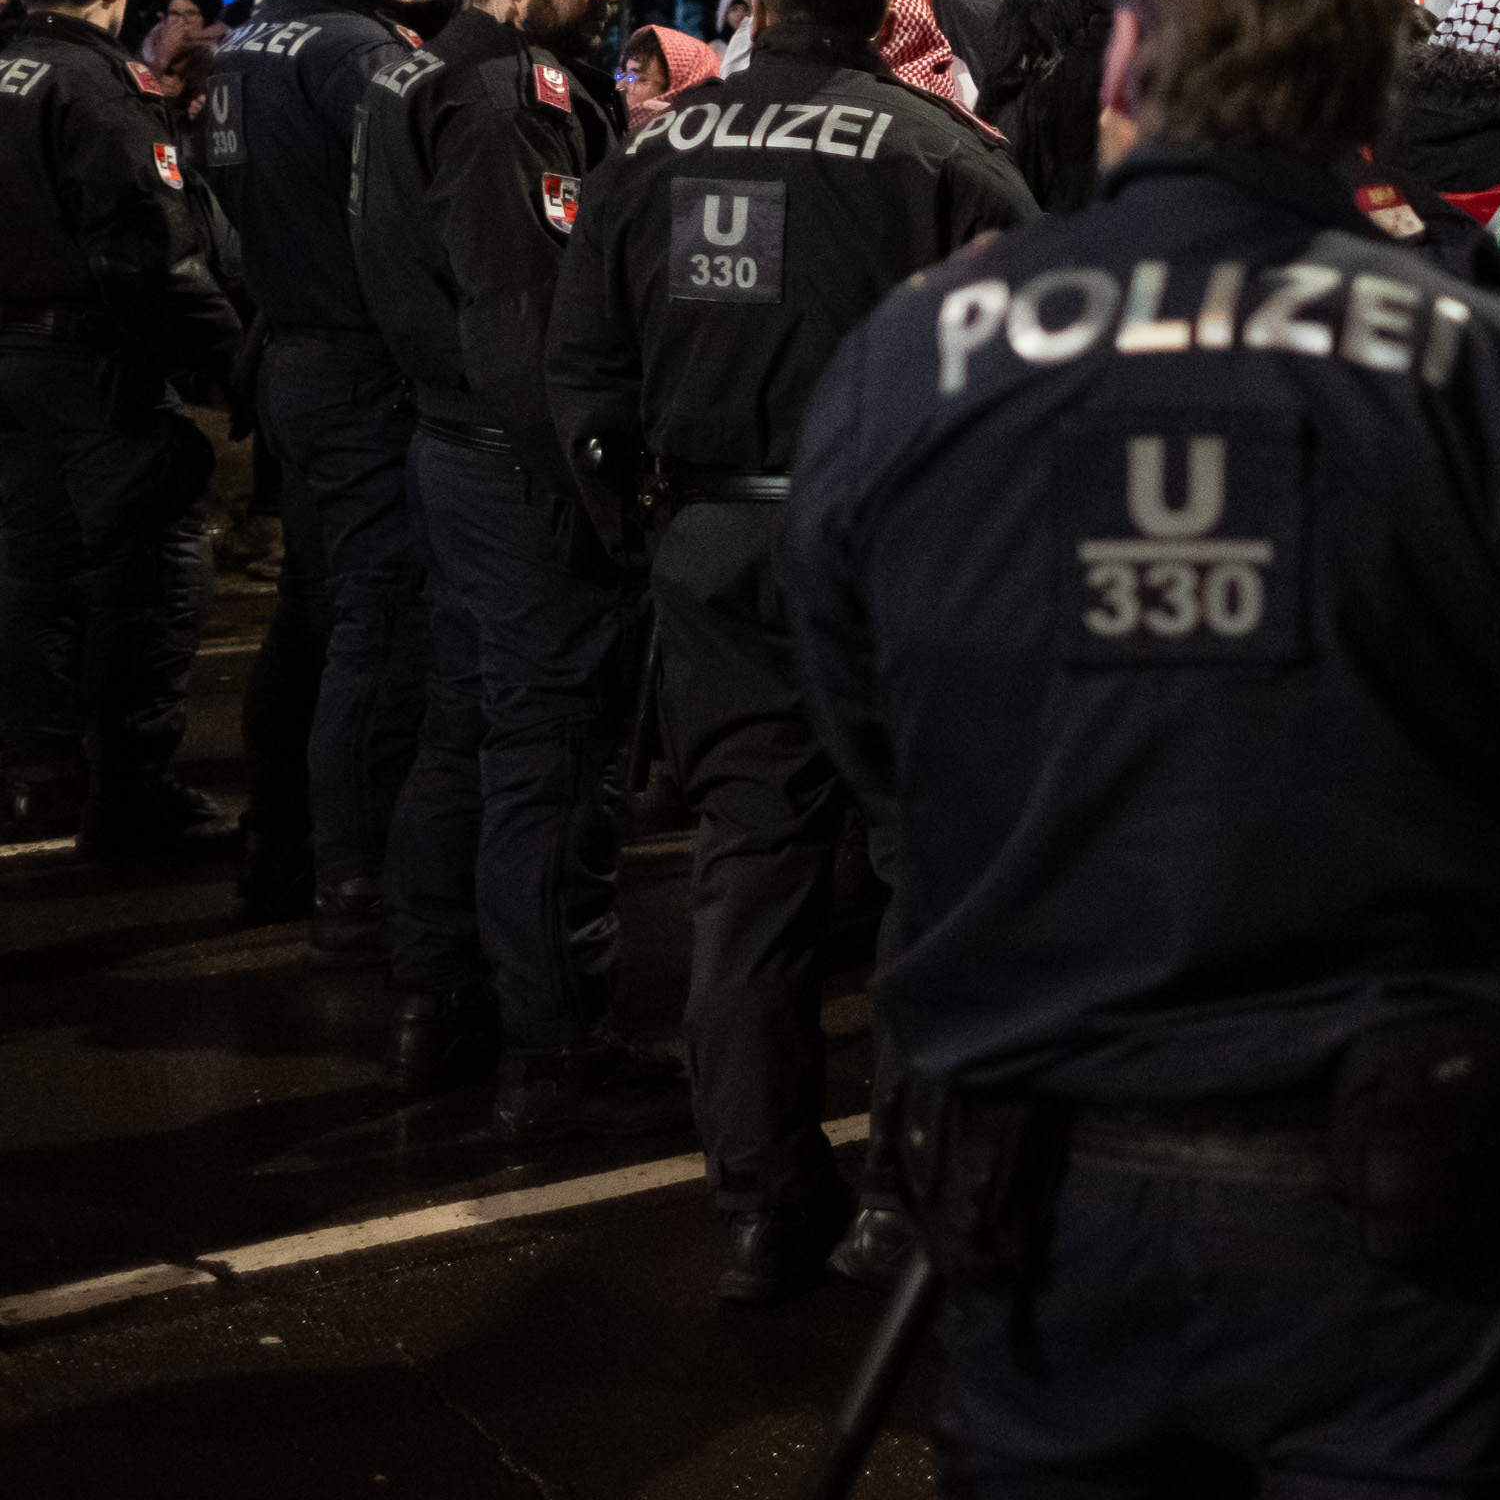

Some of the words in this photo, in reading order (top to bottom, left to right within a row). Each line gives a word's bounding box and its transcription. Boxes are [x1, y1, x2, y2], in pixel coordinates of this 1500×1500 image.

[212, 85, 229, 125] U
[626, 102, 893, 160] POLIZEI
[703, 194, 749, 247] U
[690, 253, 758, 288] 330
[938, 260, 1470, 393] POLIZEI
[1126, 434, 1227, 538] U
[1083, 560, 1265, 637] 330
